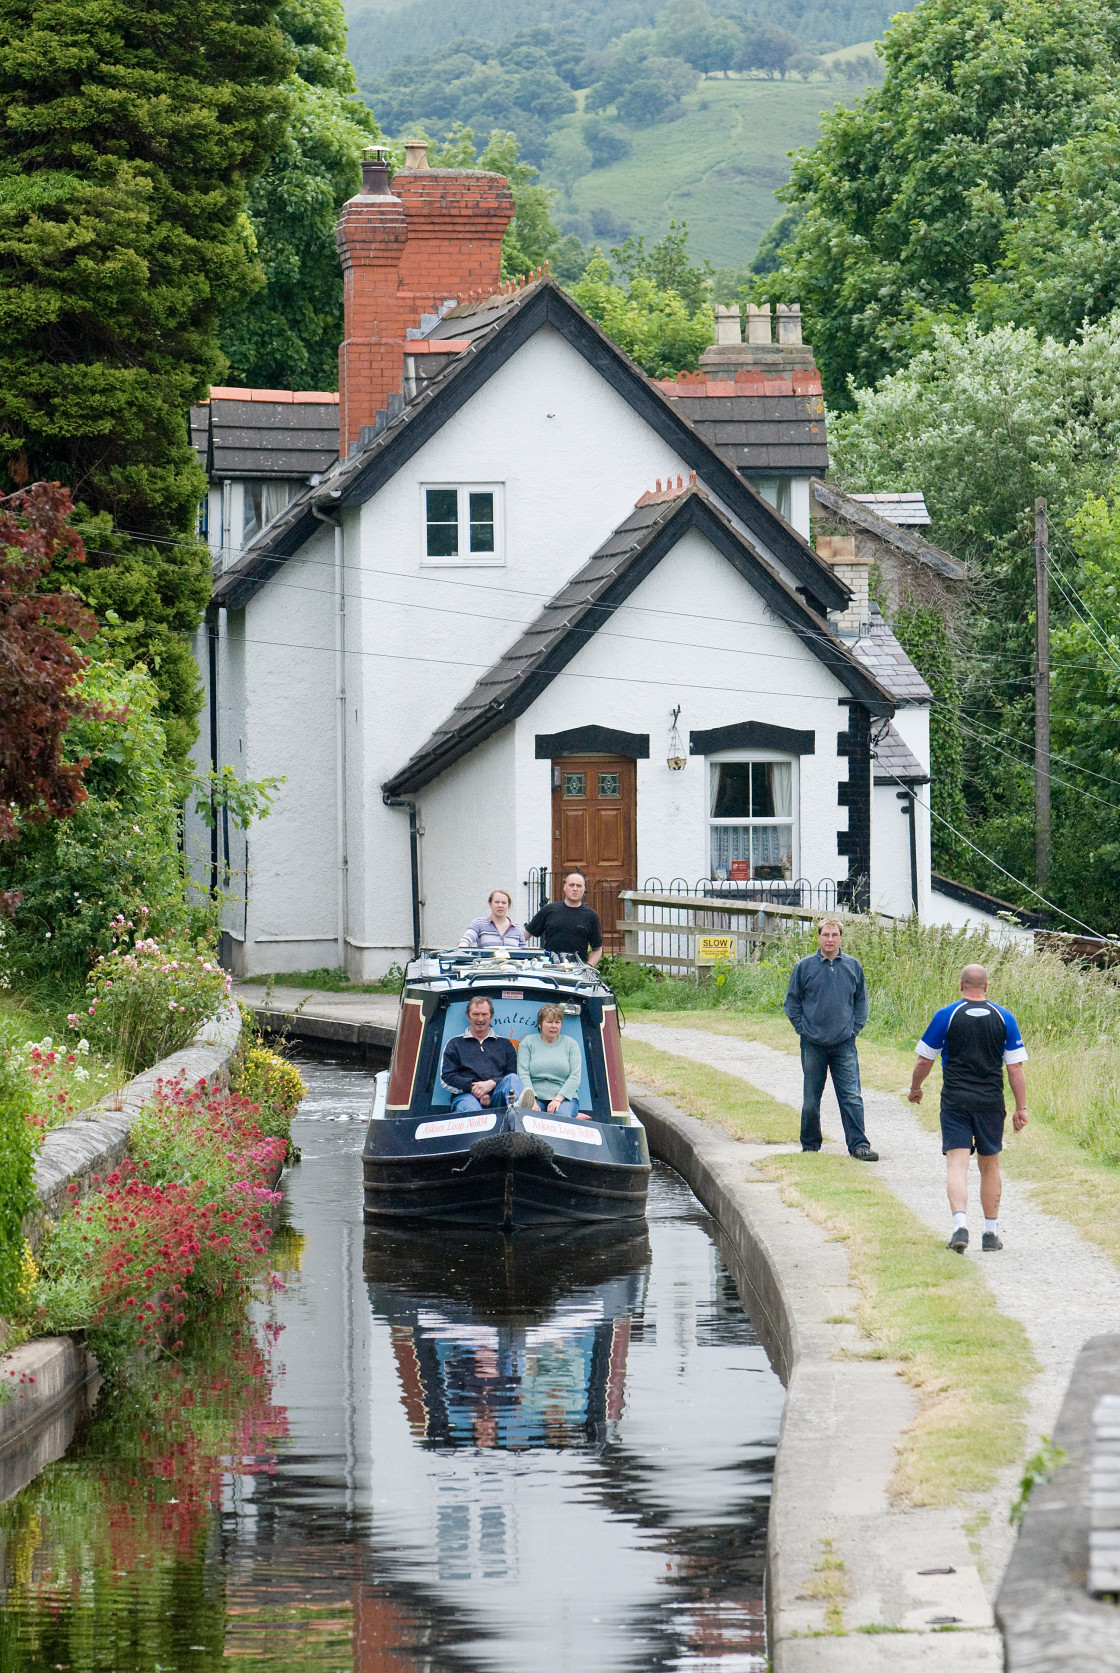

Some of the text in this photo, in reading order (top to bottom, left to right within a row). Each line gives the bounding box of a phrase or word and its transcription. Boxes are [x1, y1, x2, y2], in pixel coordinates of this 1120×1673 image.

[702, 939, 728, 947] SLOW
[423, 1123, 445, 1134] Askam
[446, 1120, 465, 1132] Loop
[532, 1119, 556, 1132] Askam
[558, 1123, 576, 1137] Loop
